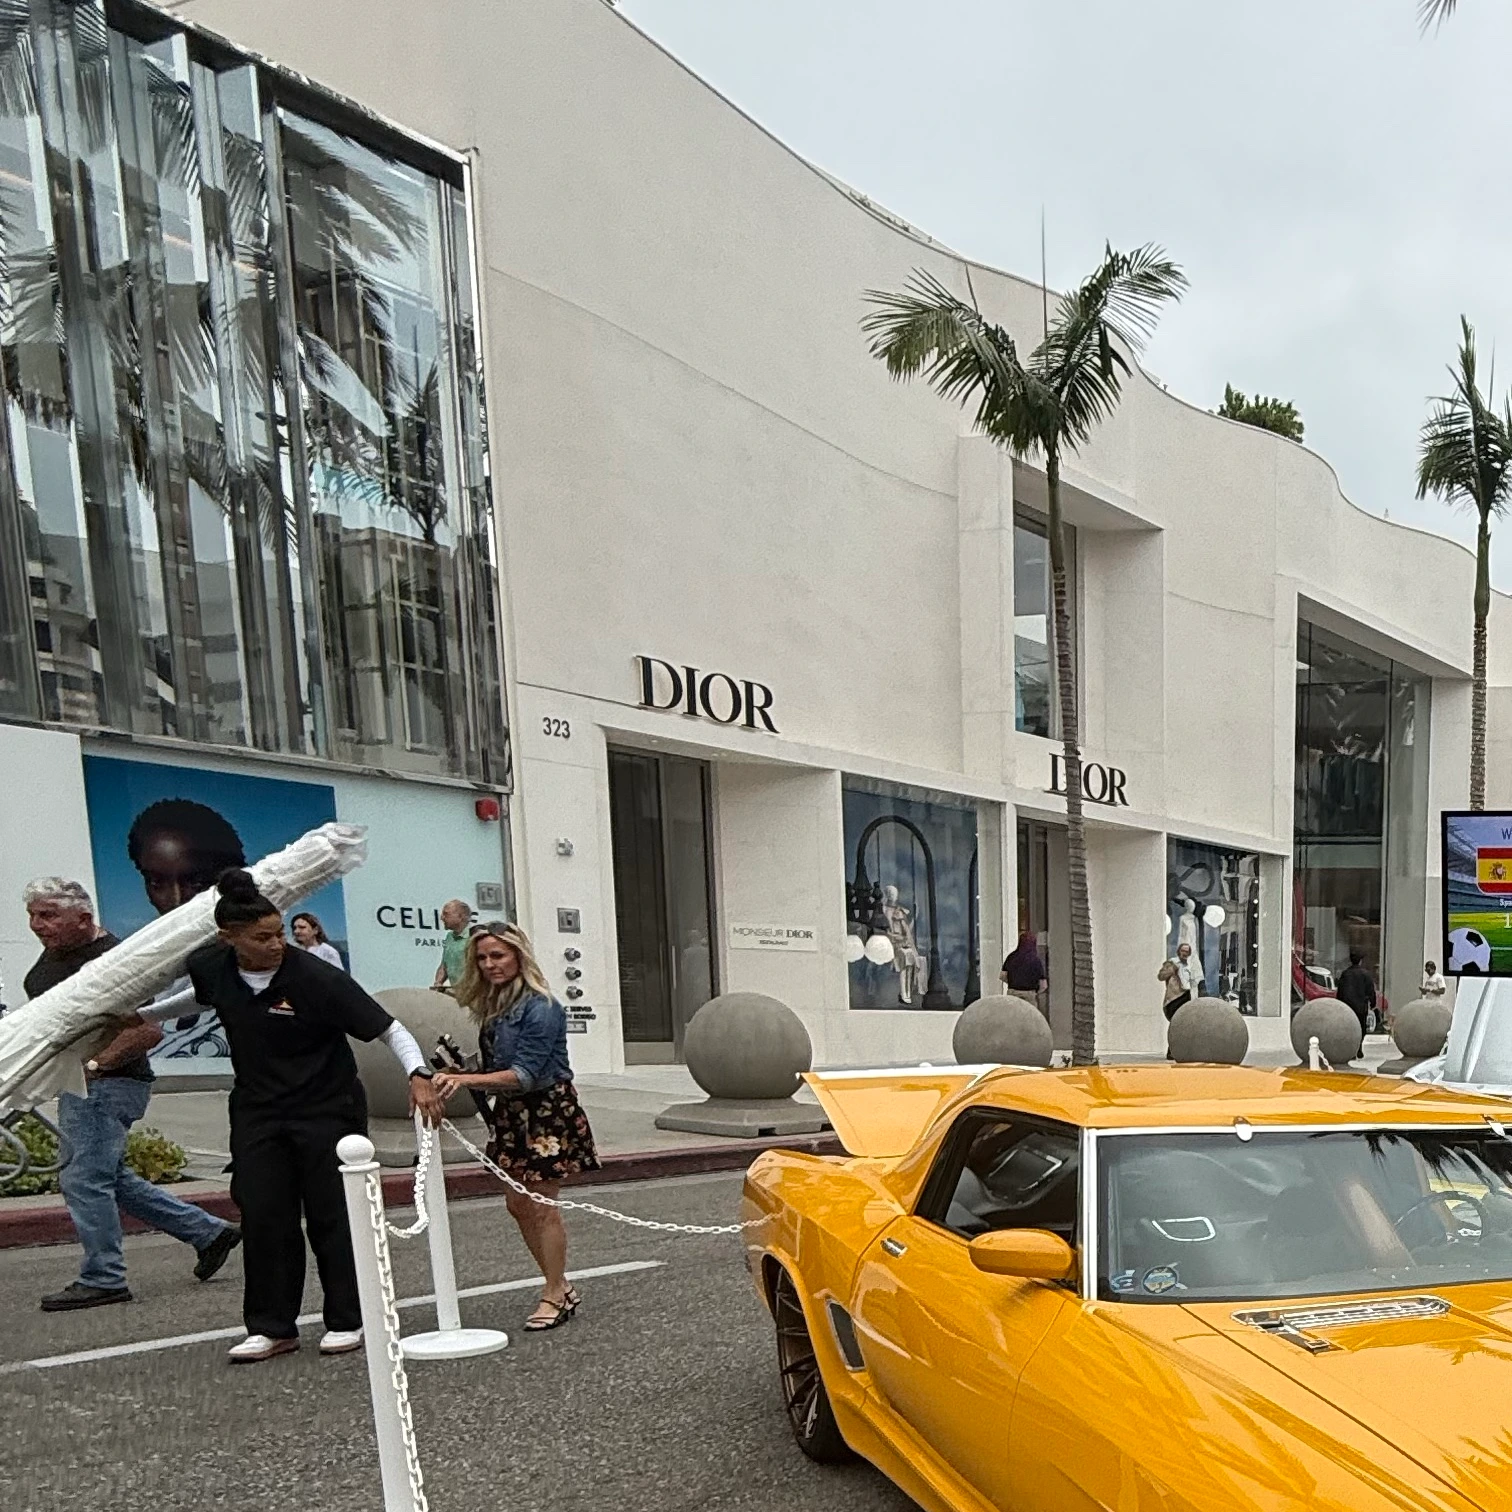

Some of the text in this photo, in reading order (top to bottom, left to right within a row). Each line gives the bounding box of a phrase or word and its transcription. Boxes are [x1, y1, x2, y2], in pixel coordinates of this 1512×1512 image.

[636, 655, 781, 734] DIOR
[542, 716, 571, 739] 323
[1049, 752, 1130, 806] DOR
[1504, 913, 1512, 929] 1
[415, 938, 447, 947] PARIS
[786, 929, 814, 939] DIOR
